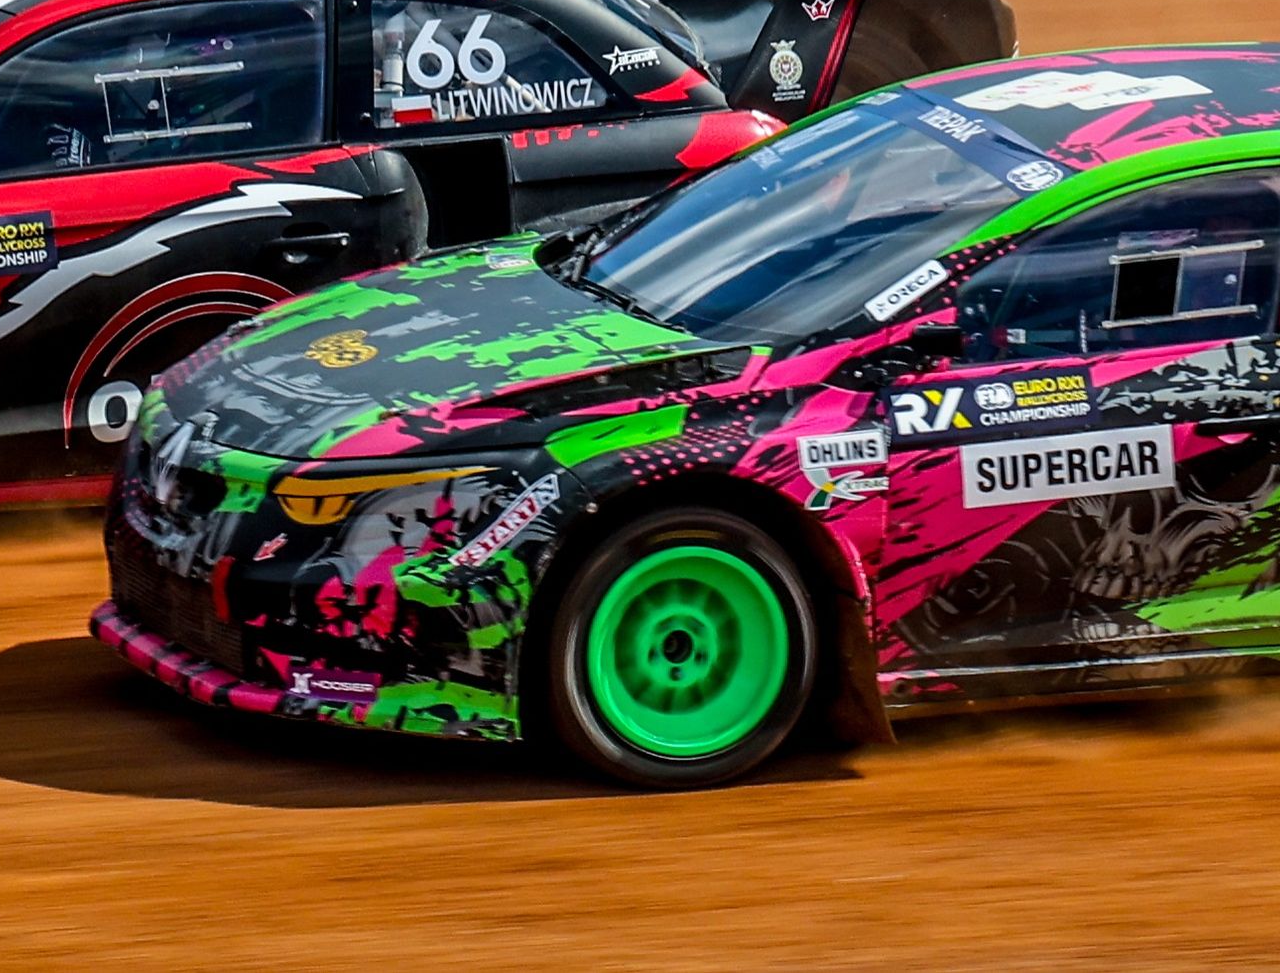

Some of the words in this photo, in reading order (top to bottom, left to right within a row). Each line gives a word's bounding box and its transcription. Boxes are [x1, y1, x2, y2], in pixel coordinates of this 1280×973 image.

[406, 13, 507, 90] 66
[434, 76, 596, 121] LITWINOWICZ
[916, 105, 987, 143] TREPÁK
[19, 222, 46, 237] RX1
[887, 269, 941, 305] ORECA
[1012, 378, 1058, 396] EURO
[1058, 375, 1086, 390] RX1
[1016, 390, 1089, 407] RALLYCROSS
[890, 387, 973, 436] RX
[979, 402, 1092, 427] CHAMPIONSHIP
[806, 439, 877, 464] ÖHLINS
[976, 439, 1160, 494] SUPERCAR
